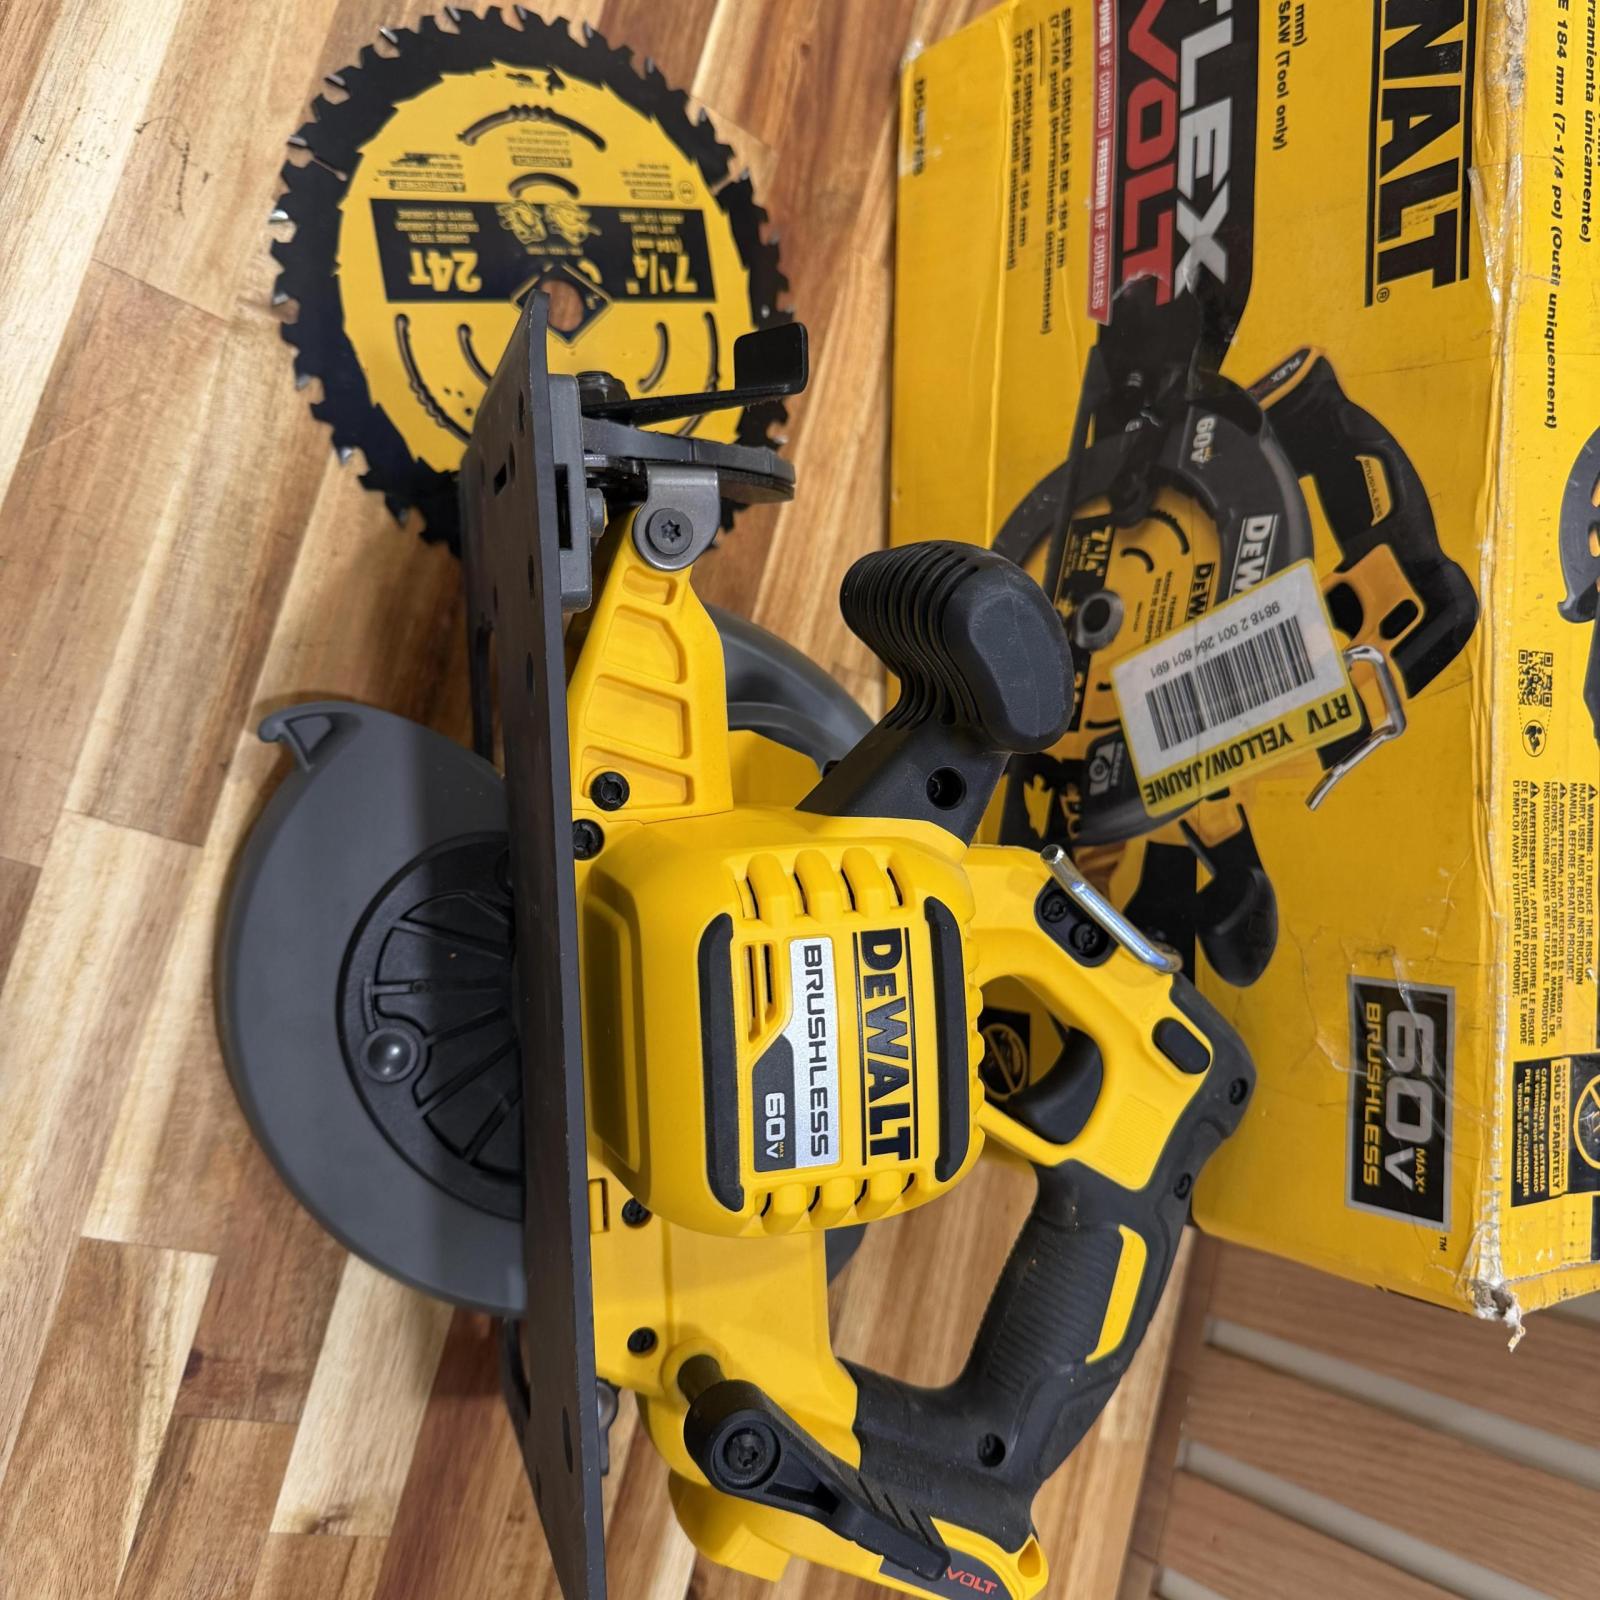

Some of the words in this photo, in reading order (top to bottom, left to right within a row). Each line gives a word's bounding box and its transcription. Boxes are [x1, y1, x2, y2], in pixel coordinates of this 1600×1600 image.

[1061, 8, 1072, 72] SIERRA
[1278, 0, 1290, 43] SAW
[1293, 4, 1307, 47] mm)
[1557, 20, 1568, 59] 184
[1099, 50, 1111, 69] OF
[1275, 50, 1290, 99] (Tool
[1097, 72, 1111, 129] CORDED
[1555, 65, 1565, 106] mm
[1060, 77, 1072, 164] CIRCULAR
[1273, 105, 1288, 150] only)
[1174, 0, 1233, 299] LEX
[1552, 113, 1566, 179] (7-1/4
[1060, 170, 1069, 193] DE
[1095, 138, 1109, 211] FREEDOM
[1580, 109, 1596, 243] únicamente)
[1094, 214, 1106, 230] OF
[1551, 185, 1563, 219] po)
[408, 250, 482, 293] 24T
[1056, 238, 1066, 268] mm
[1092, 234, 1105, 310] CORDLESS
[1544, 292, 1559, 429] uniquement)
[1234, 515, 1273, 596] DEW
[1188, 563, 1212, 621] DEW
[1250, 601, 1281, 625] 9818
[1193, 636, 1216, 655] 264
[1218, 624, 1239, 644] 001
[1239, 619, 1249, 631] 2
[1150, 661, 1170, 679] 691
[1168, 649, 1192, 667] 801
[1307, 694, 1352, 734] RTV
[1143, 722, 1293, 806] YELLOW/JAUNE
[1512, 780, 1520, 831] D'EMPLOI
[1521, 781, 1528, 794] DE
[1569, 783, 1577, 826] MANUAL
[1578, 783, 1586, 821] INJURY,
[1520, 798, 1528, 862] BLESSURES,
[1551, 838, 1557, 850] EL
[1568, 830, 1576, 868] BEFORE
[1577, 855, 1585, 882] MUST
[1586, 860, 1593, 871] TO
[1512, 873, 1520, 930] D'UTILISER
[1520, 865, 1529, 940] L'UTILISATEUR
[1544, 906, 1550, 920] DE
[1567, 872, 1575, 929] OPERATING
[1513, 934, 1520, 947] LE
[1531, 927, 1537, 940] DE
[1576, 917, 1584, 985] INSTRUCTION
[1512, 950, 1520, 998] PRODUIT.
[1529, 944, 1538, 989] RÉDUIRE
[1543, 972, 1549, 985] EL
[1551, 961, 1557, 973] EL
[1558, 960, 1564, 972] EL
[1566, 933, 1574, 982] PRODUCT.
[1520, 998, 1527, 1010] LE
[1529, 992, 1536, 1004] LE
[1541, 988, 1549, 1047] PRODUCTO.
[1528, 1008, 1536, 1046] RISQUE
[1549, 1024, 1555, 1038] DE
[1556, 1016, 1562, 1030] DE
[804, 944, 828, 1157] BRUSHLESS
[861, 928, 910, 1161] DEWALT
[1362, 1002, 1381, 1186] BRUSHLESS
[1523, 1097, 1530, 1112] DE
[1539, 1068, 1547, 1132] CARGADOR
[765, 1092, 786, 1158] 60V
[1523, 1116, 1529, 1129] ET
[1552, 1106, 1560, 1189] SEPARATELY
[945, 1566, 998, 1595] VOLT
